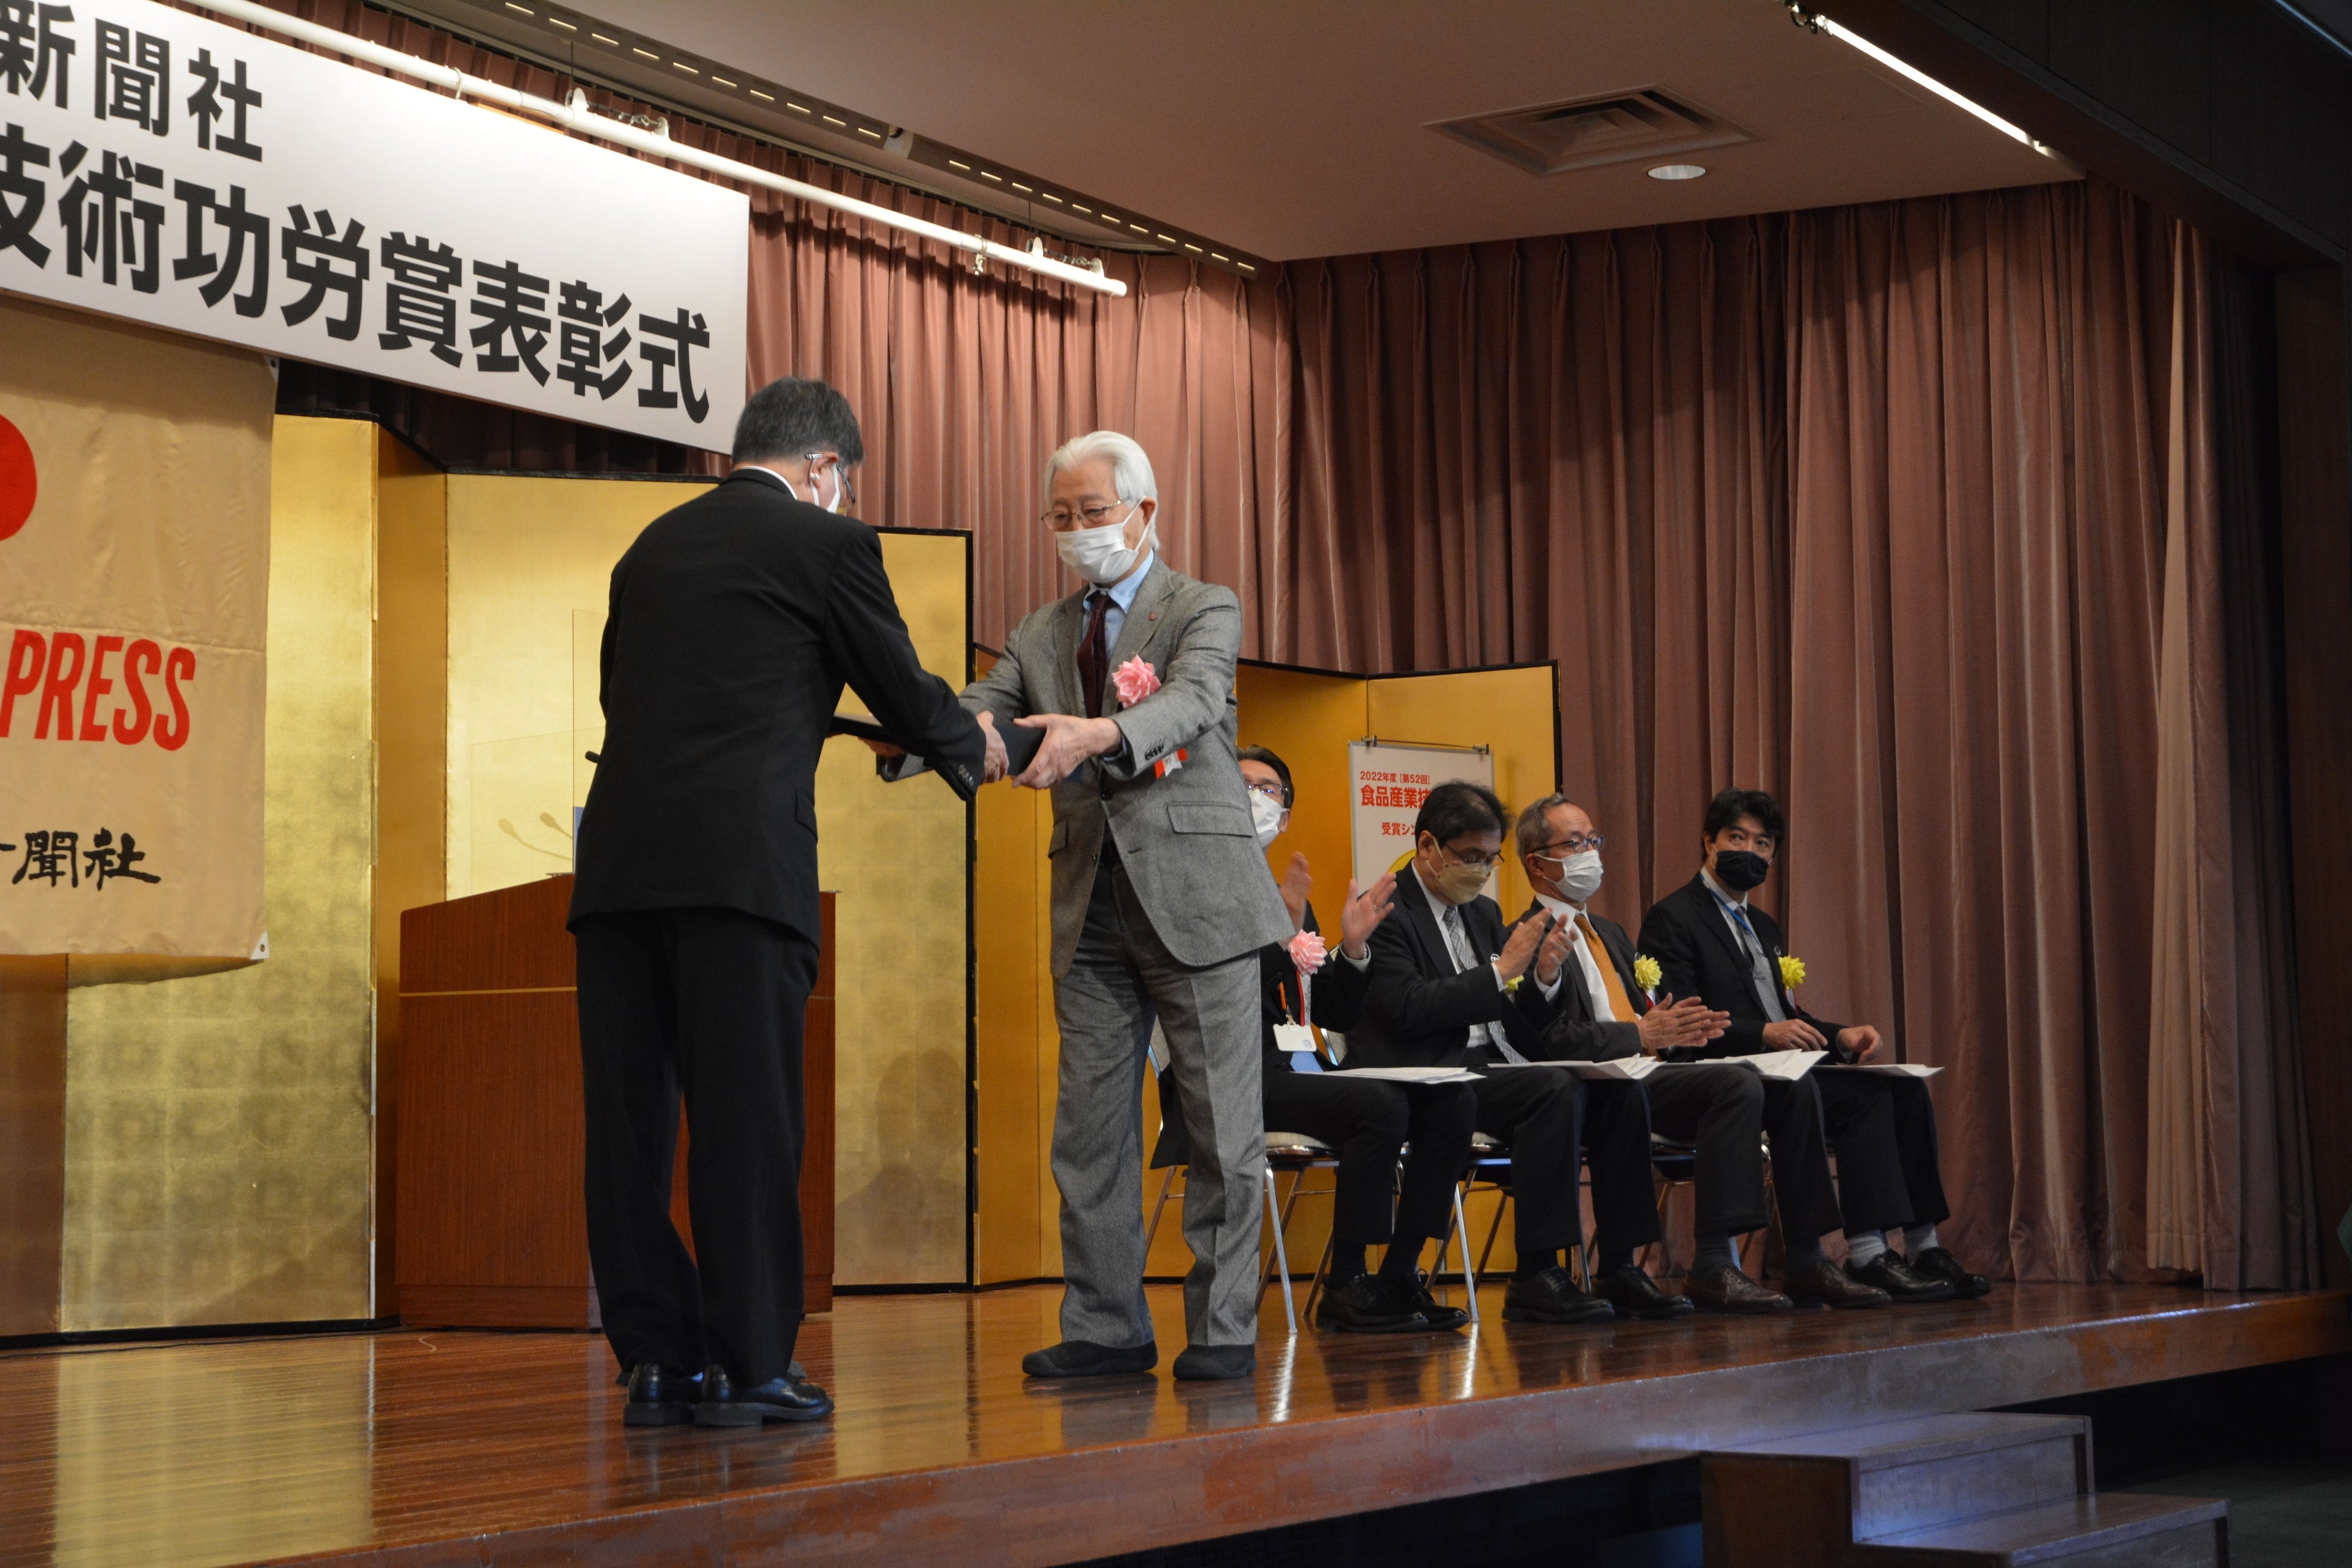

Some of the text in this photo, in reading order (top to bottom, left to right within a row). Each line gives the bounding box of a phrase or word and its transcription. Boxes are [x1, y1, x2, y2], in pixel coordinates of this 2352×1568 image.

[0, 0, 262, 162] 新聞社
[0, 629, 196, 751] PRESS
[0, 827, 161, 891] 聞社
